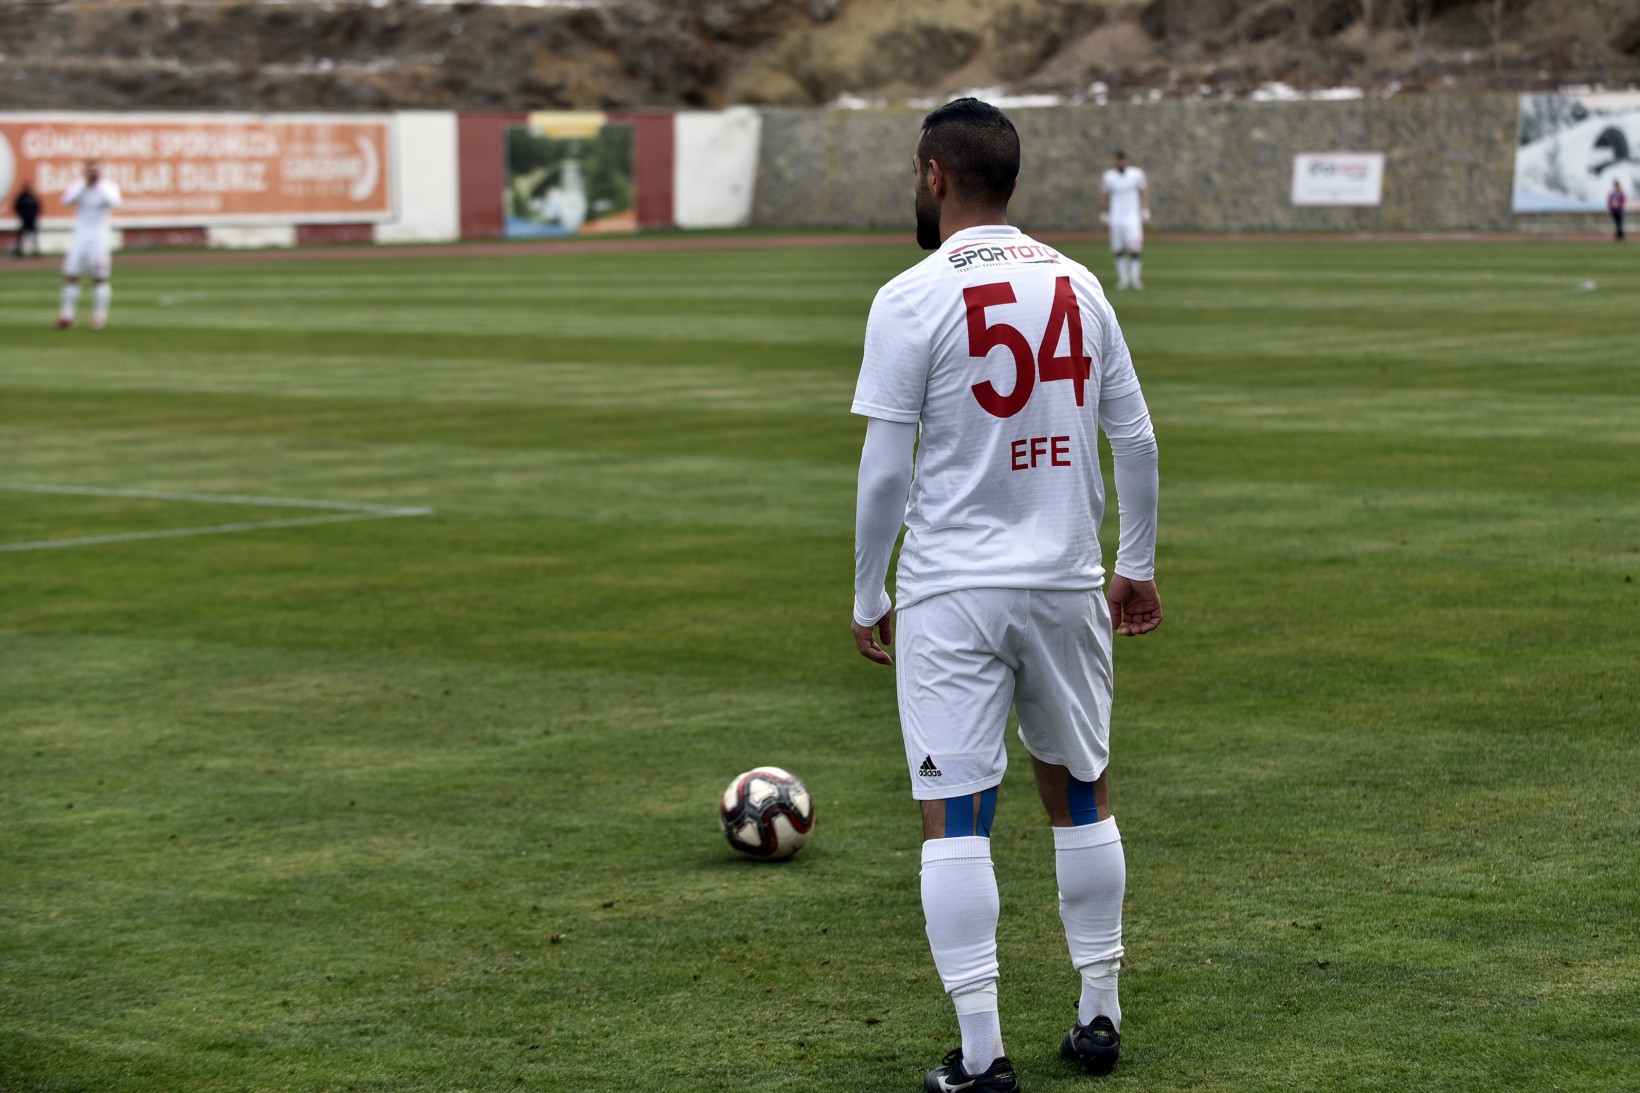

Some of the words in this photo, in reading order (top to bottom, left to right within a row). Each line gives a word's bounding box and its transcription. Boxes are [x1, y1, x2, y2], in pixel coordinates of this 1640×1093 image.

[963, 276, 1092, 418] 54
[1011, 436, 1071, 471] EFE
[919, 769, 942, 777] adidas
